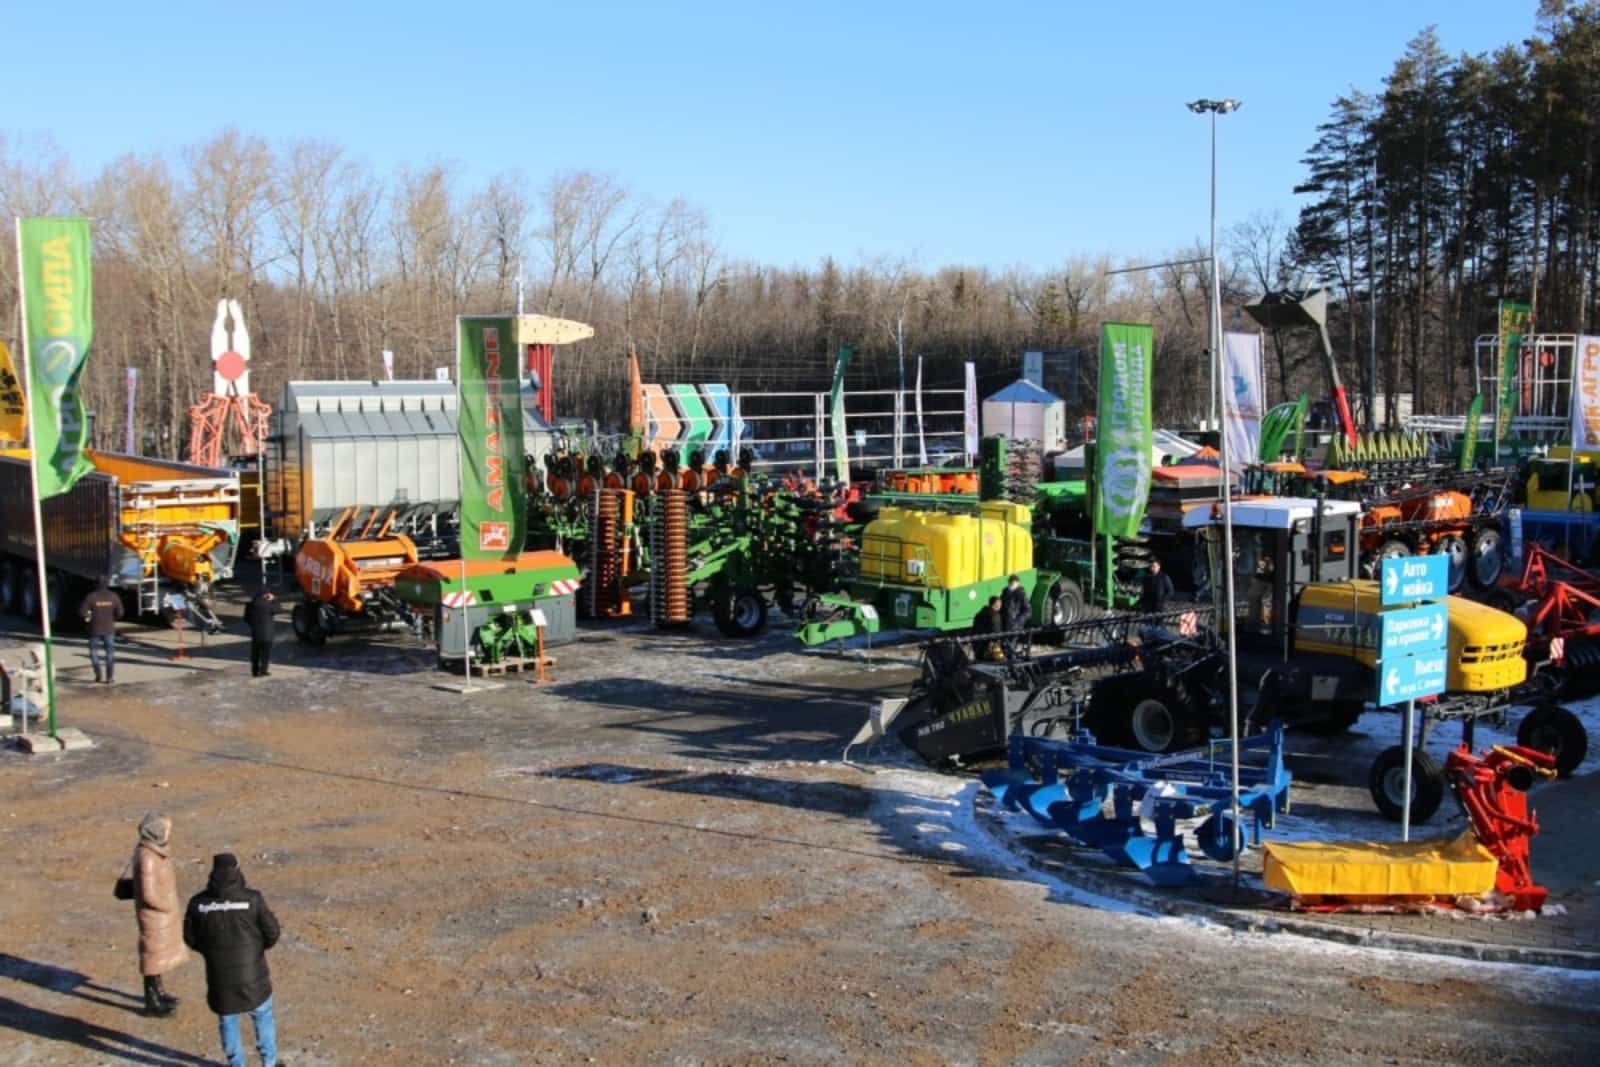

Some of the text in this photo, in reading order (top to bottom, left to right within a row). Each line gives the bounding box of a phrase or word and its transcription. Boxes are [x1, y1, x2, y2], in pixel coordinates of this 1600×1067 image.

[41, 233, 72, 337] СИЛА
[482, 327, 505, 513] AMAZONE
[1112, 342, 1129, 441] АГРОДОМ
[1131, 344, 1145, 444] АРТЕМИДА
[1402, 561, 1428, 577] Авто
[1402, 578, 1434, 596] мойка
